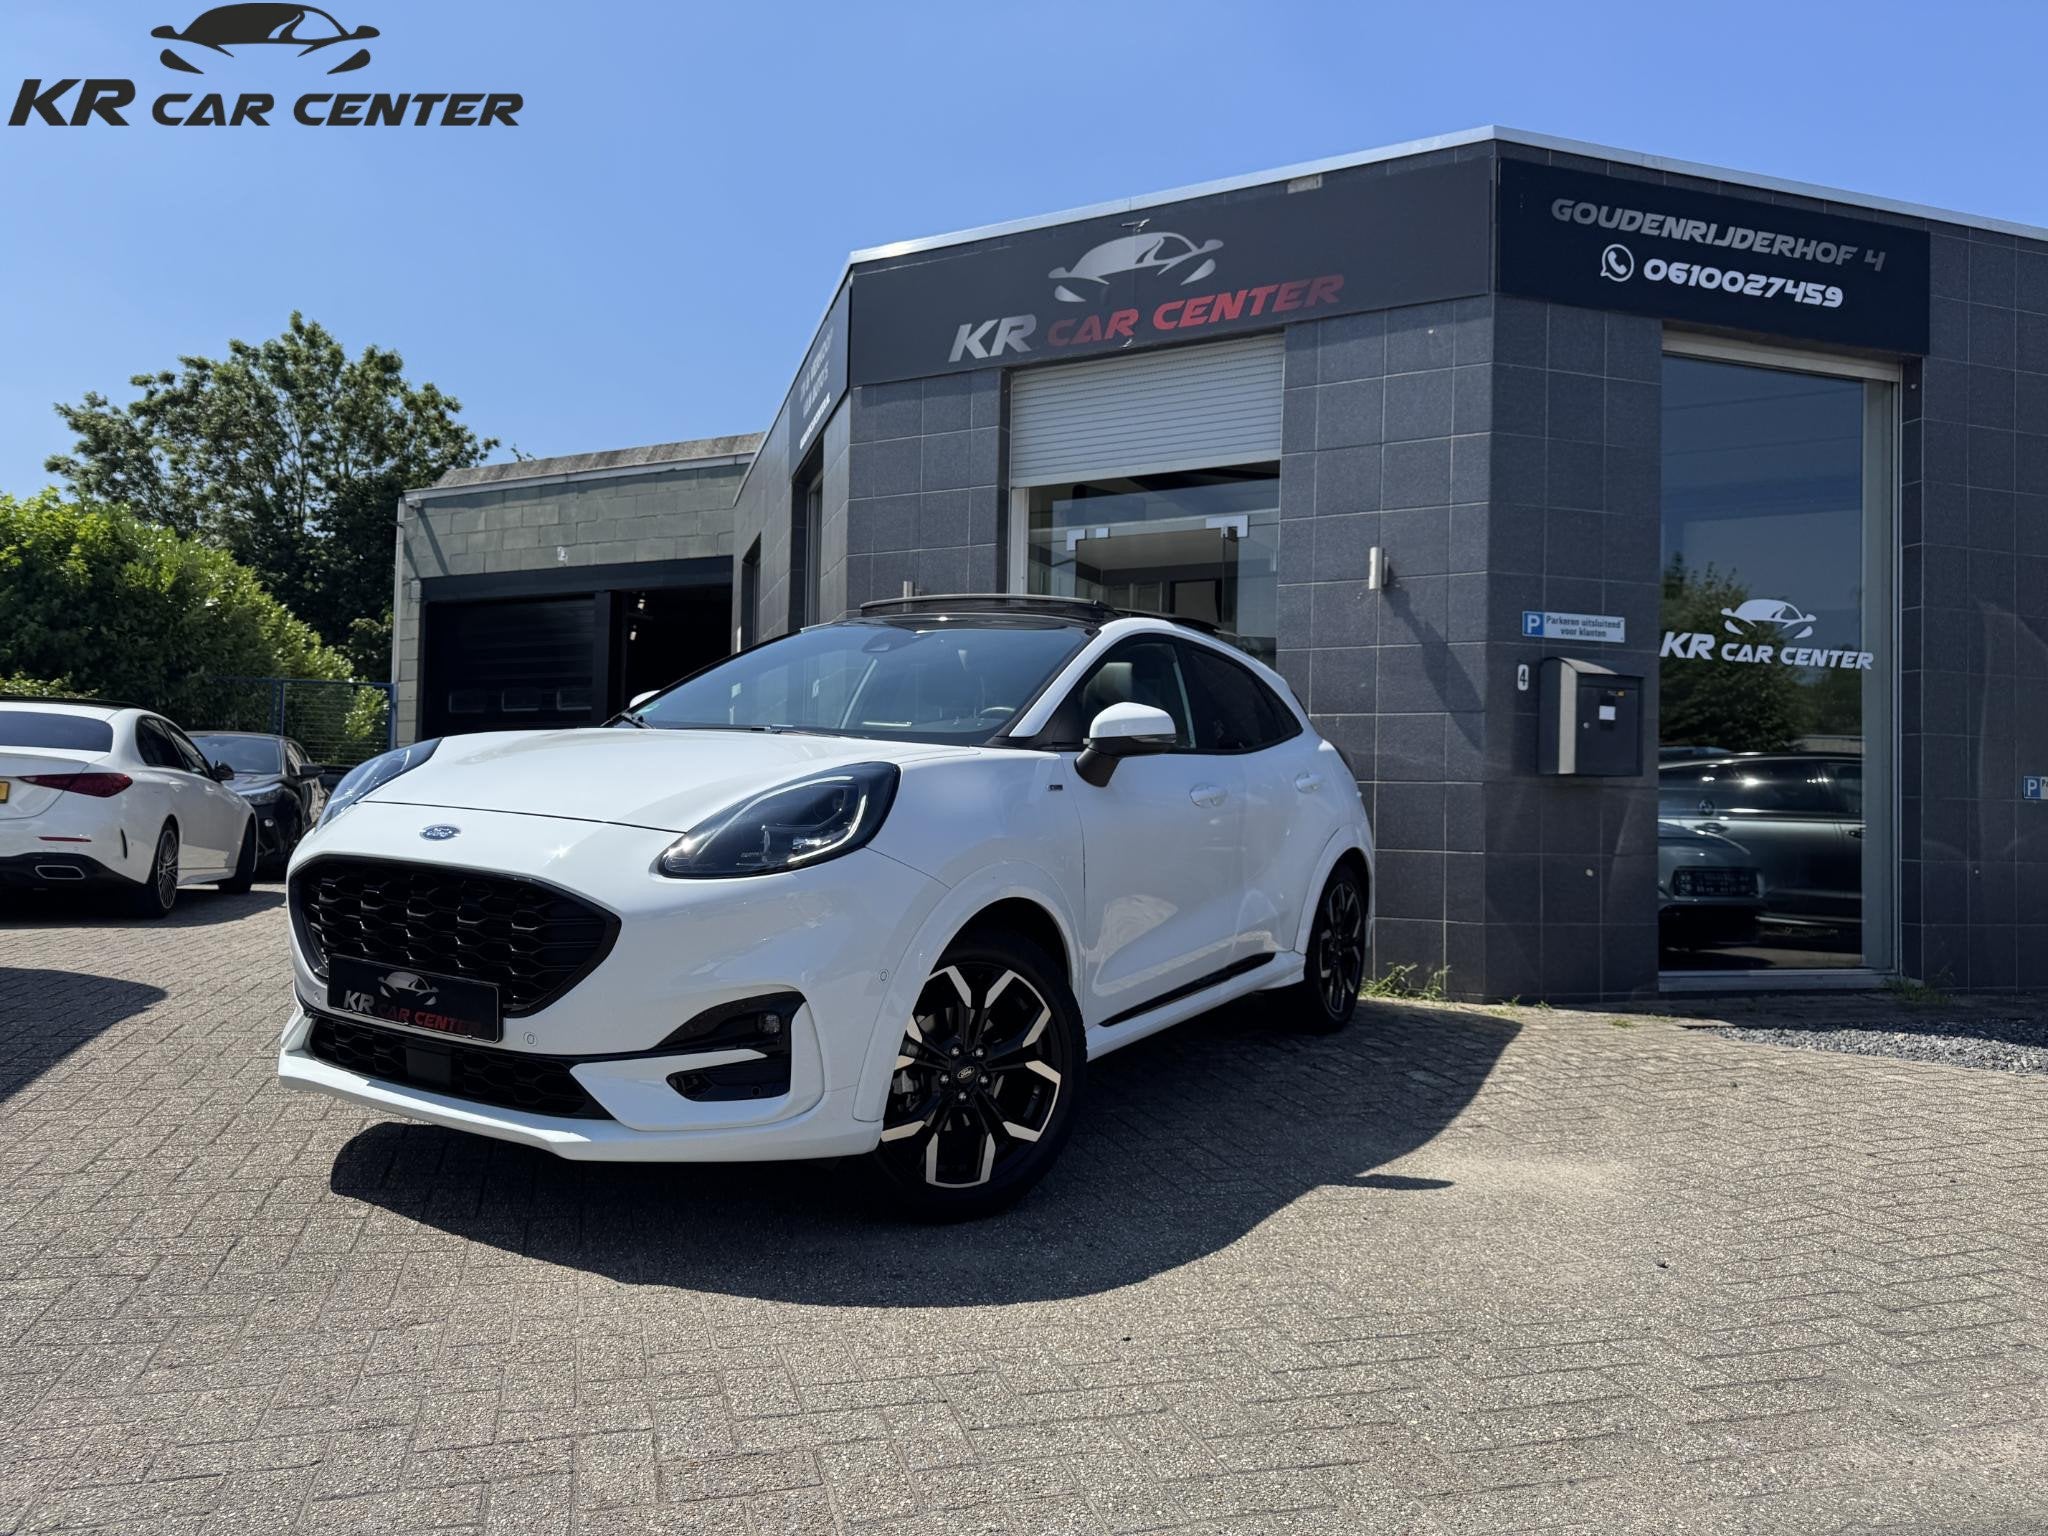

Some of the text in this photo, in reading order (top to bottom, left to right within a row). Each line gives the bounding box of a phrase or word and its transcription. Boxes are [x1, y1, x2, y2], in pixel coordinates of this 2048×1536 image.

[1551, 198, 1886, 272] GOUDENRIJDERHOF 4
[1643, 258, 1844, 309] 0610027459
[948, 274, 1345, 363] KR CAR CENTER
[1527, 614, 1540, 634] P
[1546, 615, 1580, 626] Parkeren
[1579, 628, 1607, 638] klanten
[1659, 631, 1874, 671] KR CAR CENTER
[1519, 668, 1528, 686] 4
[343, 990, 375, 1014] KR
